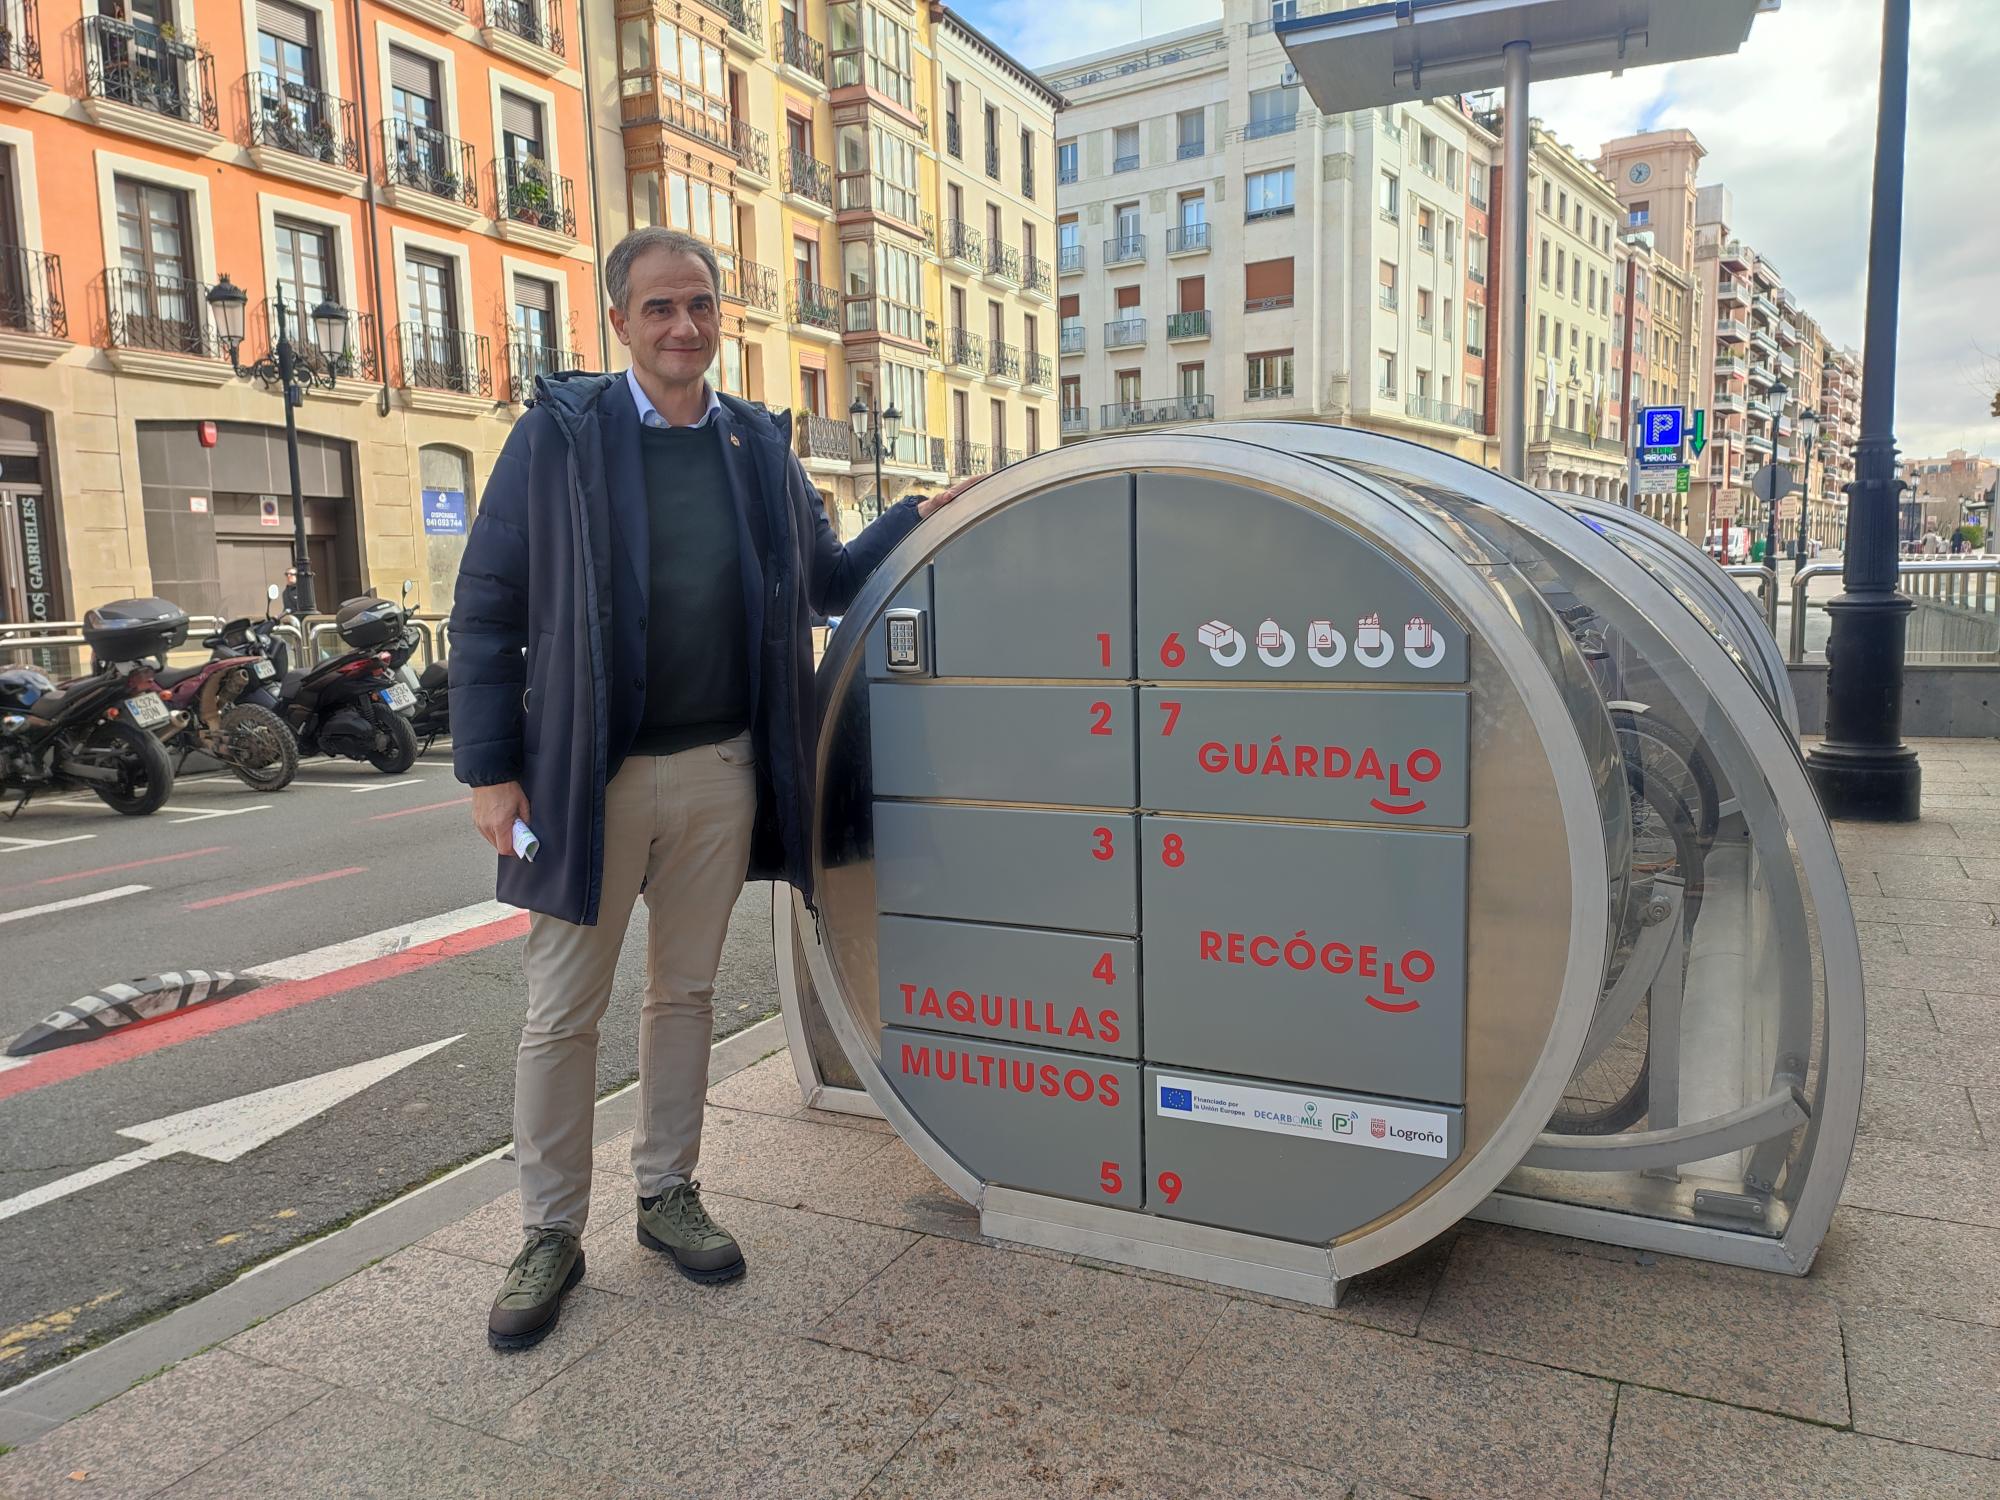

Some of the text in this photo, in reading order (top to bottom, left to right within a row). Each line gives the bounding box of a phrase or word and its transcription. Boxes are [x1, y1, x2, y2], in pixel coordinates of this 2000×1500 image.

[1652, 413, 1674, 443] P
[22, 497, 44, 589] GABRIELES
[32, 592, 47, 623] LOS
[1096, 632, 1111, 668] 1
[1159, 632, 1186, 669] 6
[1089, 701, 1112, 736] 2
[1159, 701, 1182, 737] 7
[1198, 736, 1442, 797] GUÁRDALO
[1091, 826, 1115, 862] 3
[1161, 832, 1185, 868] 8
[1091, 952, 1117, 986] 4
[1199, 930, 1436, 996] RECÓGELO
[900, 983, 1121, 1044] TAQUILLAS
[901, 1044, 1121, 1108] MULTIUSOS
[1194, 1096, 1227, 1106] Financiado
[1200, 1104, 1219, 1112] Unión
[1220, 1107, 1246, 1117] Europea
[1390, 1125, 1444, 1144] Logroño
[1100, 1160, 1123, 1195] 5
[1157, 1170, 1183, 1205] 9
